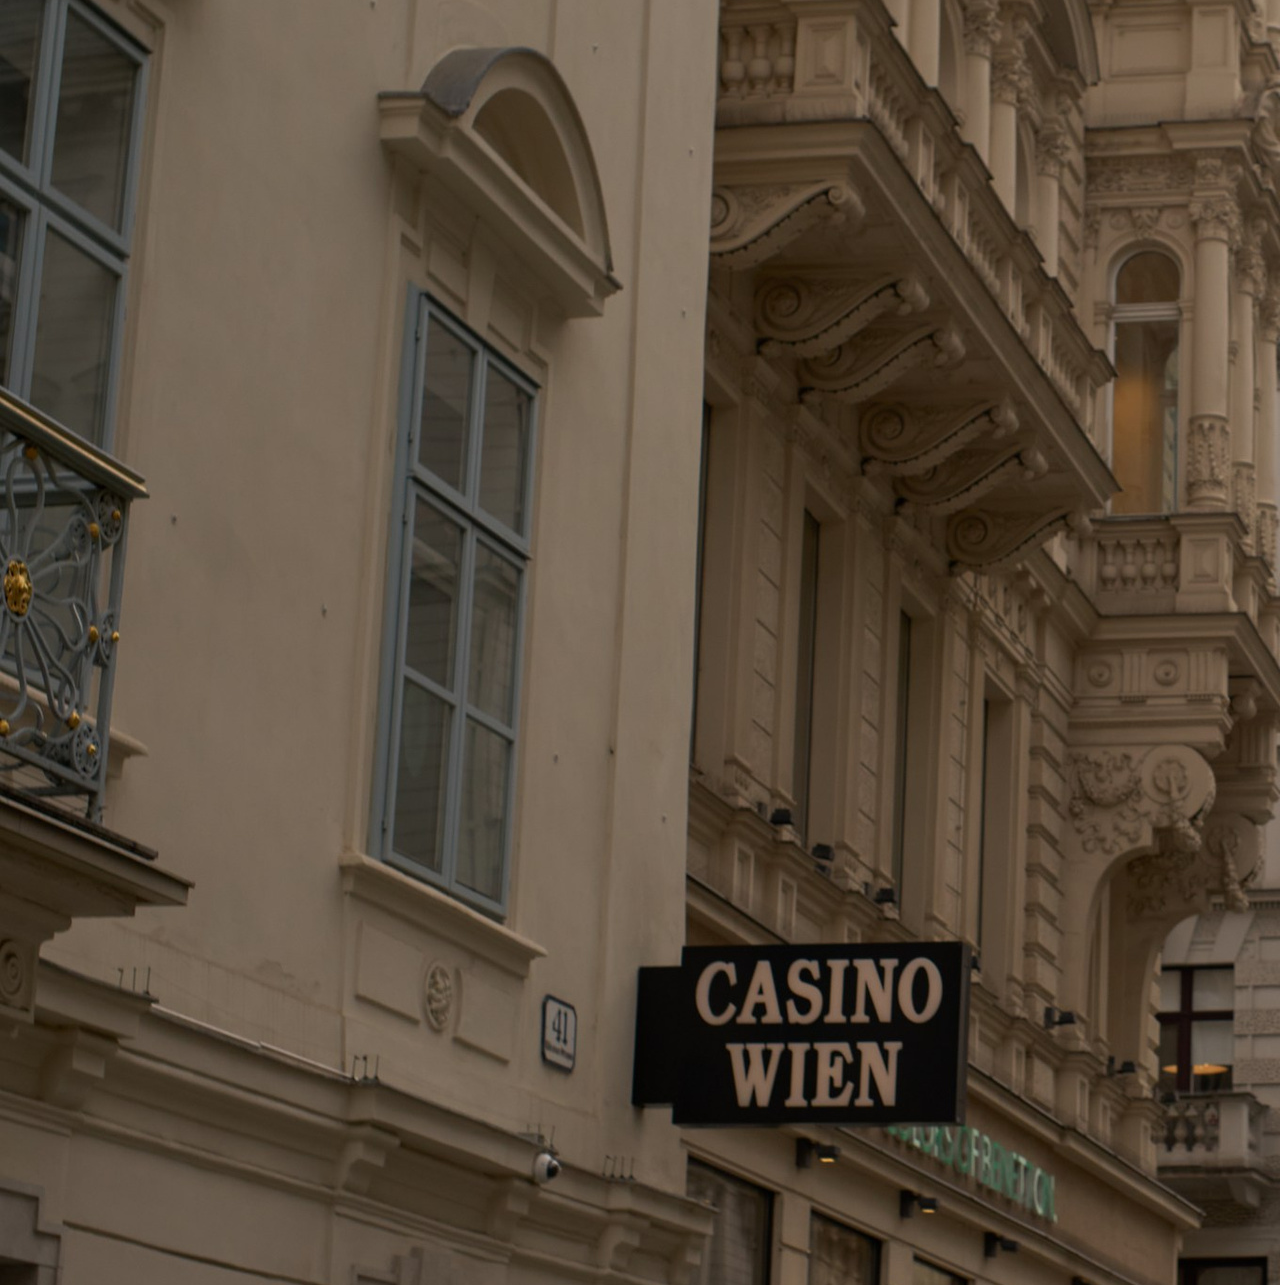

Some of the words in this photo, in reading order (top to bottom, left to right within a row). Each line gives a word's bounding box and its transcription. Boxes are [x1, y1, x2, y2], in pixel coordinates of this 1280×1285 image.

[695, 956, 943, 1026] CASINO
[552, 1008, 568, 1046] 41
[726, 1040, 903, 1108] WIEN
